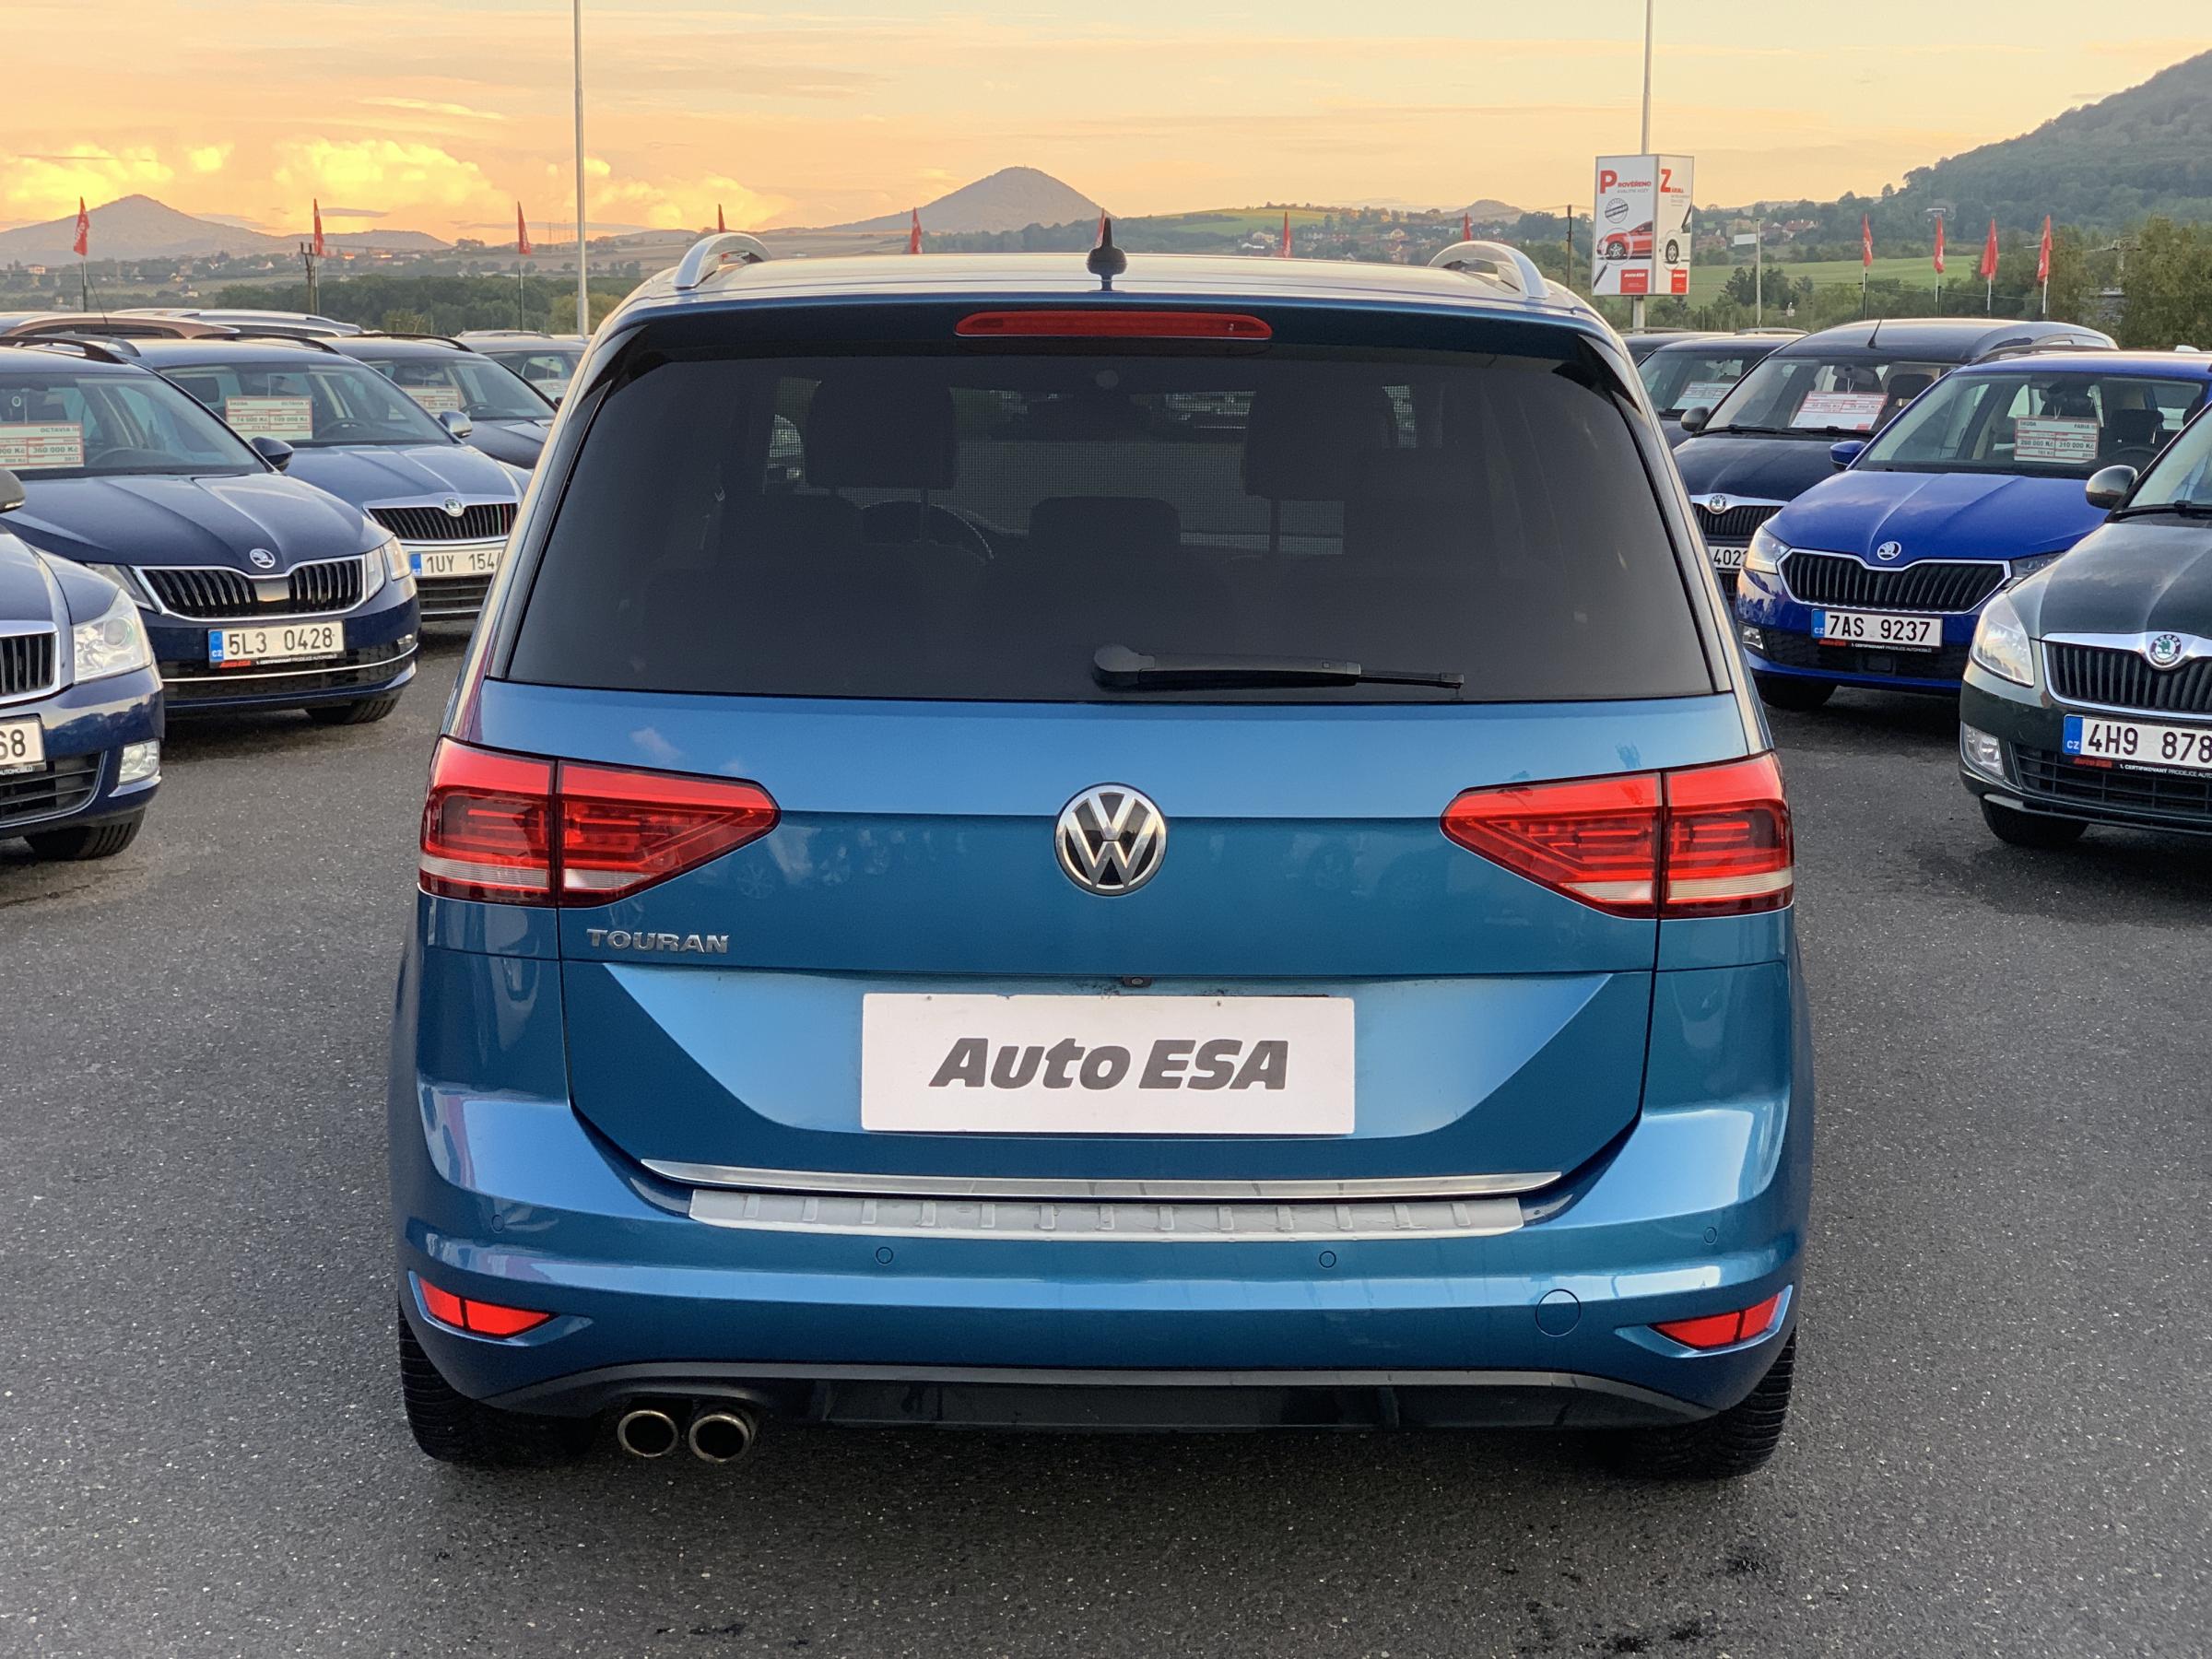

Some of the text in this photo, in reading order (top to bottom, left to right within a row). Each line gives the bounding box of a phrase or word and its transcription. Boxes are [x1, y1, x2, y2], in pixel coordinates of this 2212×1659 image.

[427, 555, 454, 573] 1UY
[1714, 548, 1748, 566] 402
[229, 627, 333, 655] 5L3 0428
[1830, 615, 1932, 642] 7AS 9237
[2066, 740, 2079, 750] CZ
[2088, 724, 2212, 763] 4H9 878
[586, 928, 729, 953] TOURAN
[928, 1038, 1288, 1090] Auto ESA
